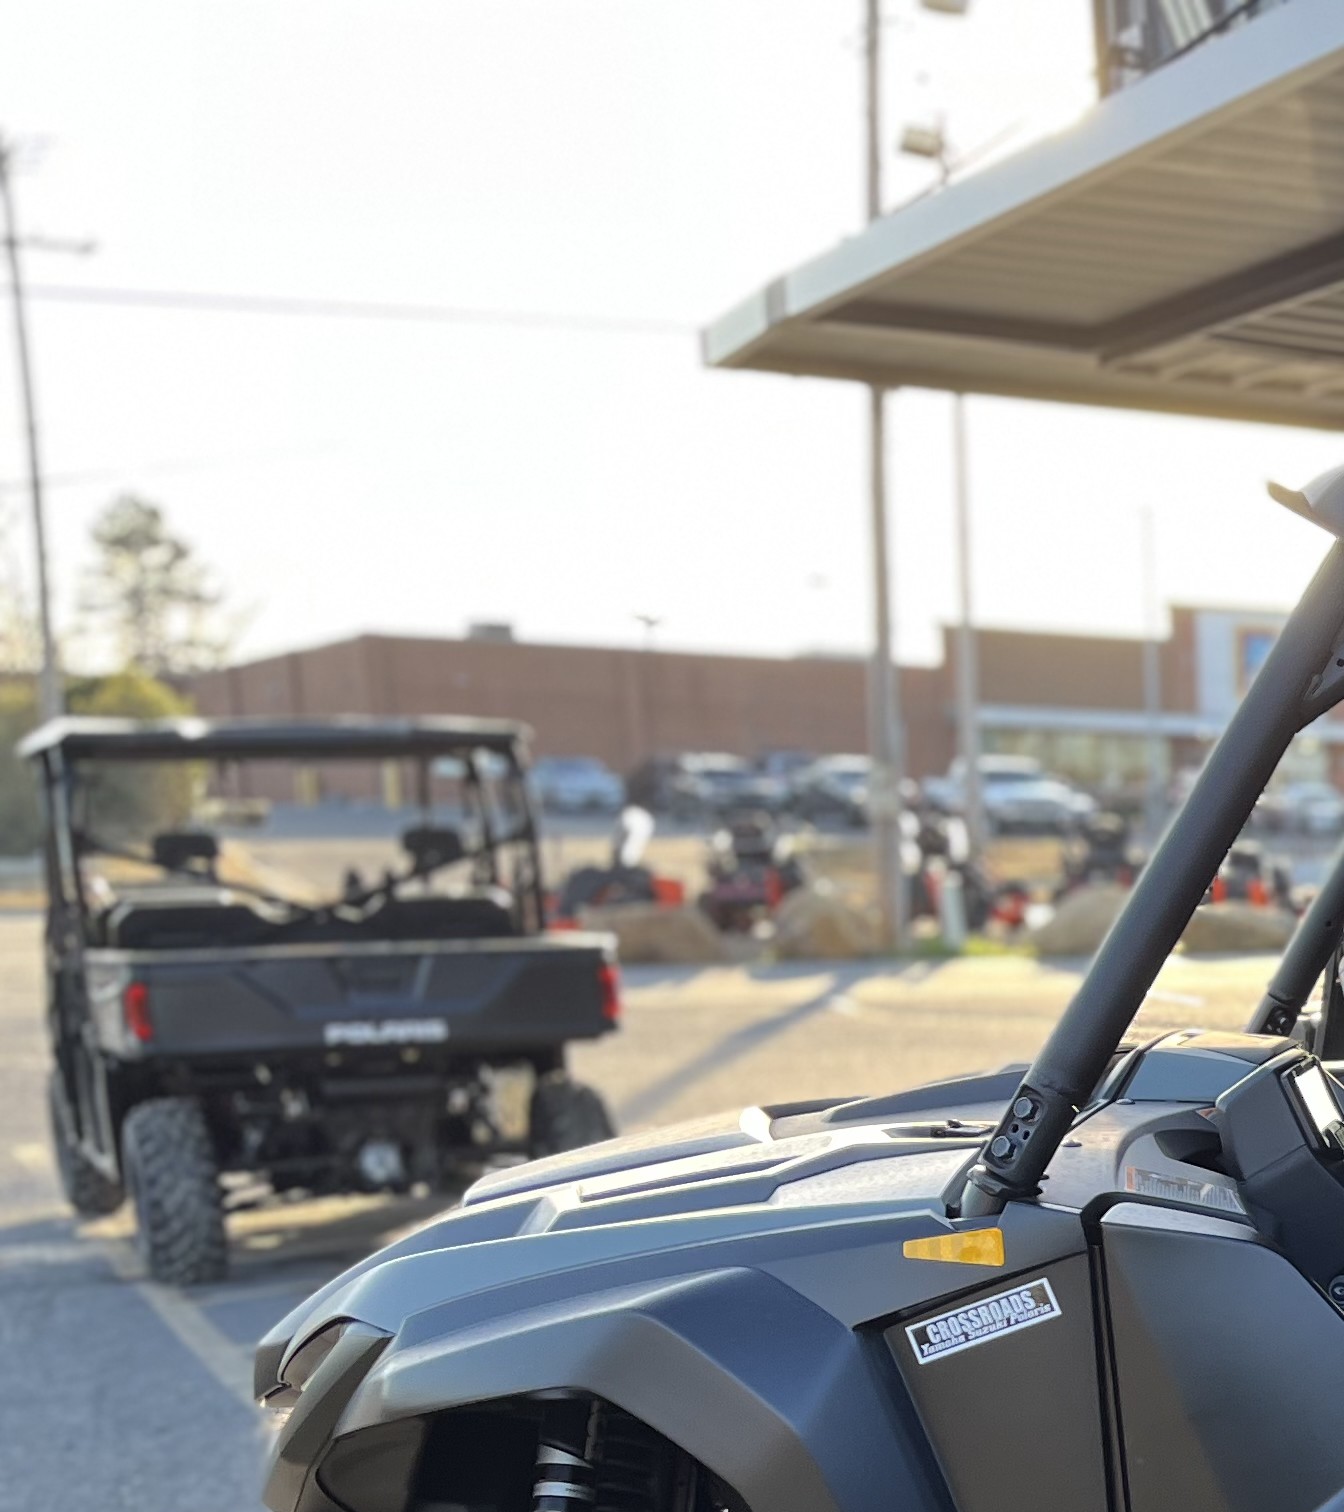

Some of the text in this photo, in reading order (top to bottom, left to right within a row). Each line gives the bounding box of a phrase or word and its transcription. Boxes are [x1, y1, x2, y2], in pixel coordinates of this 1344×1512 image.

[920, 1303, 1052, 1356] Yamaha Suzuki Polaris
[926, 1290, 1037, 1344] CROSSROADS
